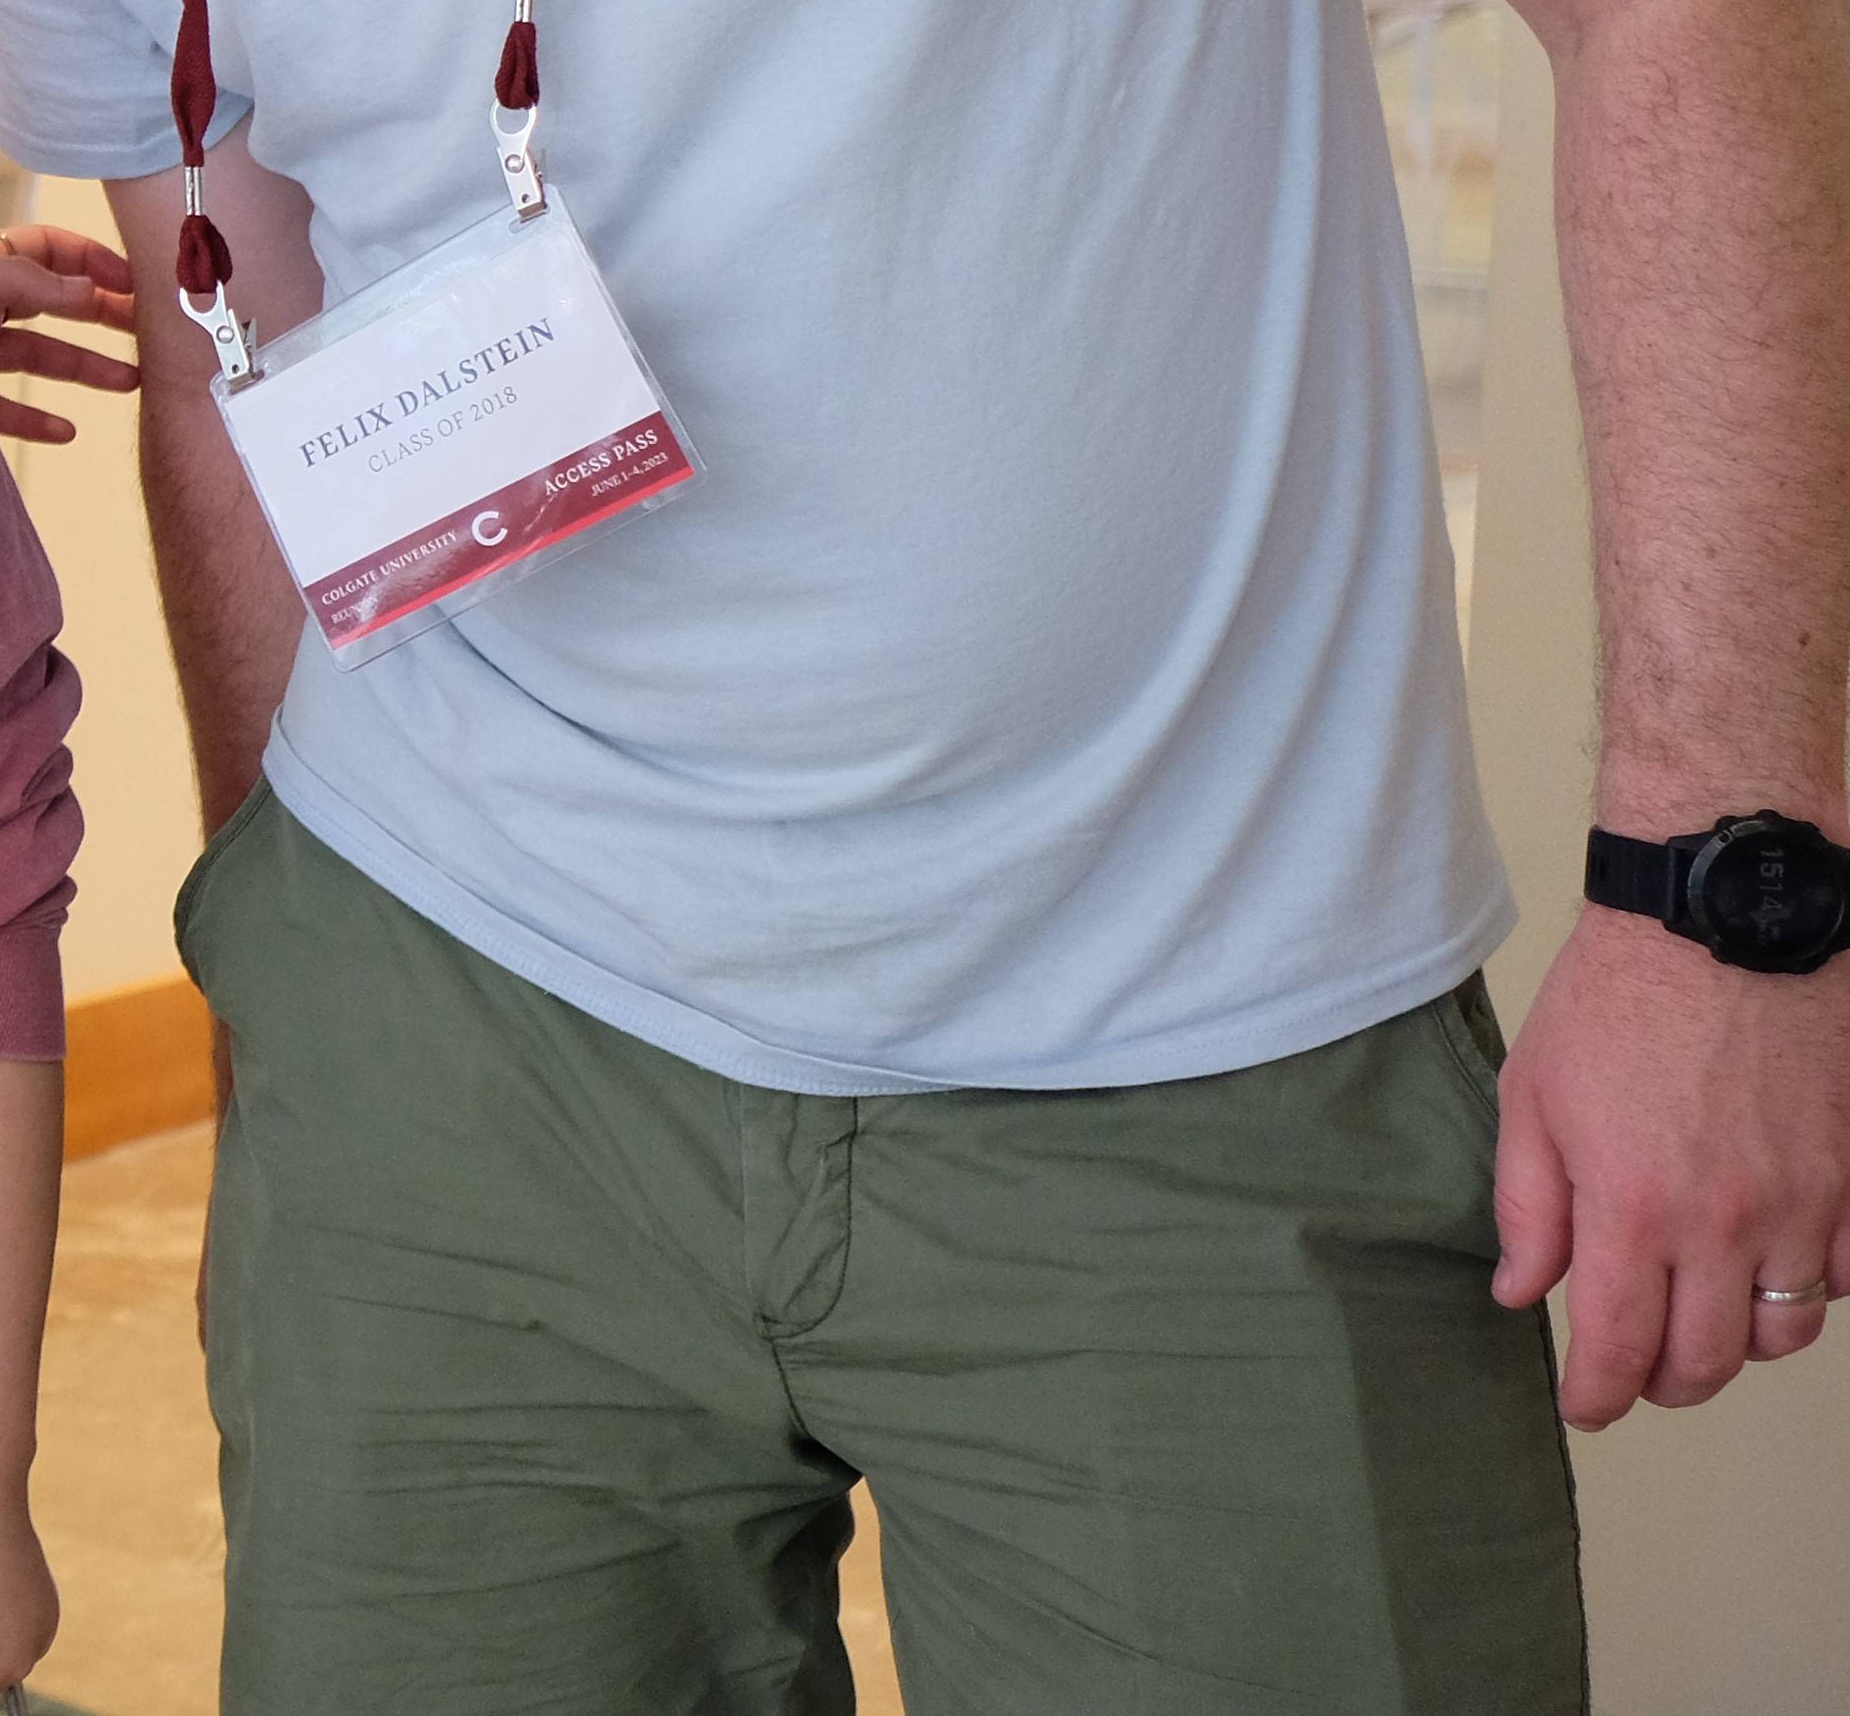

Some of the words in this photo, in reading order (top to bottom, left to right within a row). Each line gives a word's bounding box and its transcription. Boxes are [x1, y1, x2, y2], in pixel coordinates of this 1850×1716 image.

[298, 402, 393, 469] FELIX
[395, 316, 557, 418] DALSTEIN
[366, 426, 436, 474] CLASS
[436, 408, 464, 439] OF
[470, 384, 519, 422] 2018
[544, 451, 612, 496] ACCESS
[612, 428, 659, 461] PASS
[591, 474, 622, 497] JUNE
[471, 510, 508, 547] C
[321, 569, 379, 605] COLGATE
[379, 530, 458, 576] UNIVERSITY
